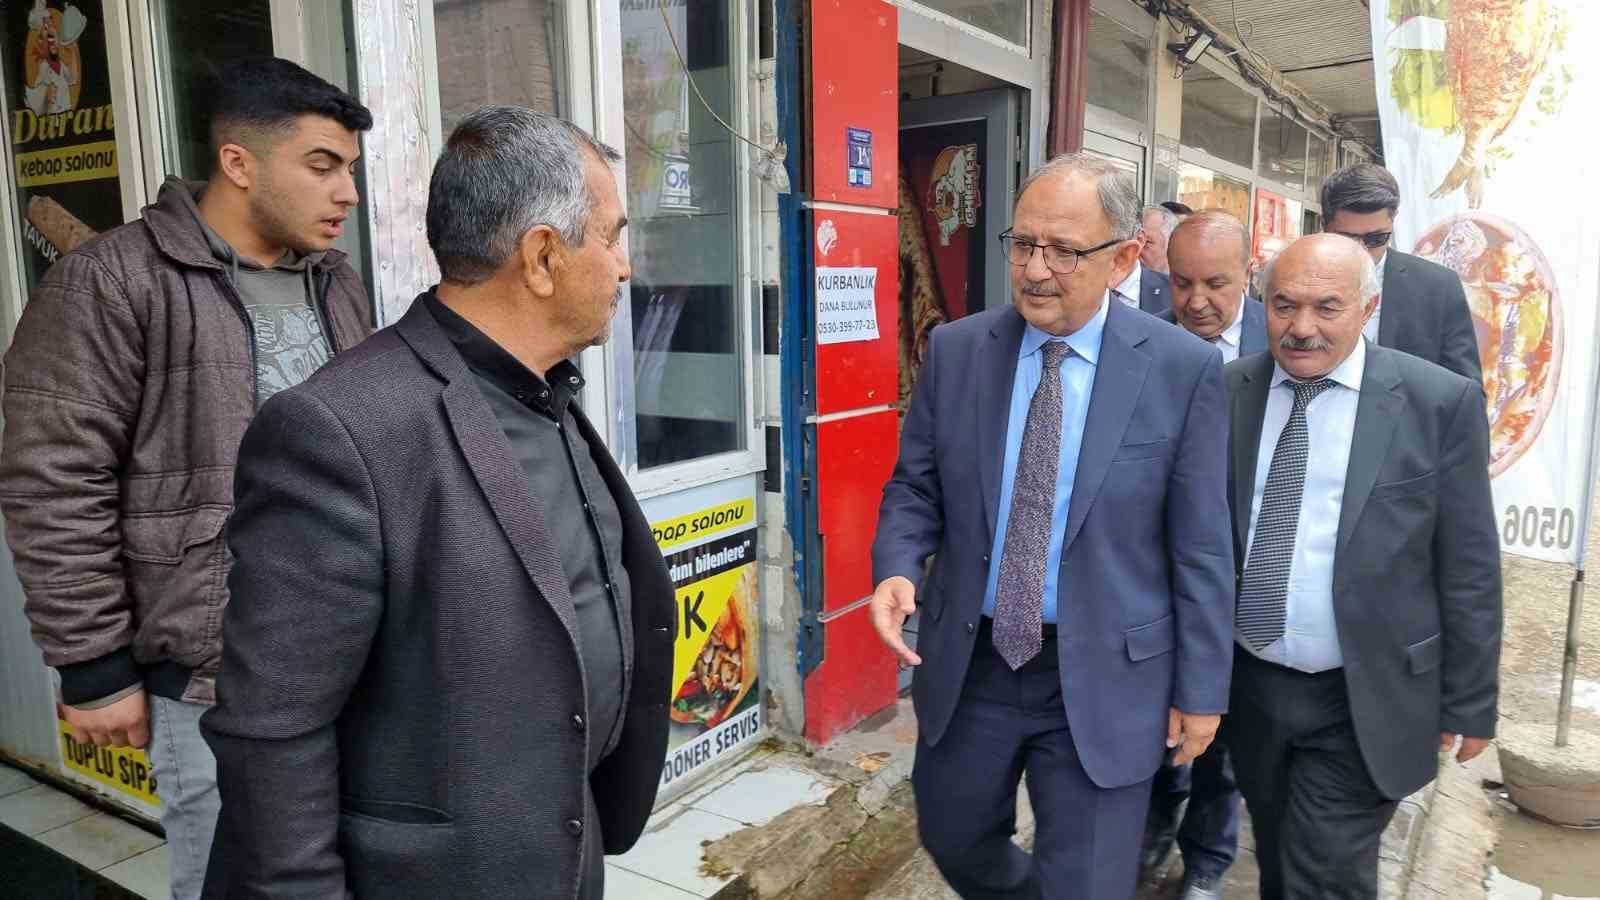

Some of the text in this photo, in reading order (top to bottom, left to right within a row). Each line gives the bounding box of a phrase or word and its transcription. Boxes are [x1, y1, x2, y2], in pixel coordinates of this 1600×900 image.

[14, 104, 113, 144] Duran
[21, 151, 113, 177] kebap salonu
[24, 218, 59, 263] TAVUK
[818, 275, 874, 290] KURBANLIK
[819, 302, 839, 313] DANA
[817, 319, 876, 335] 0530-399-77-23
[690, 505, 744, 533] salonu
[675, 590, 707, 640] K
